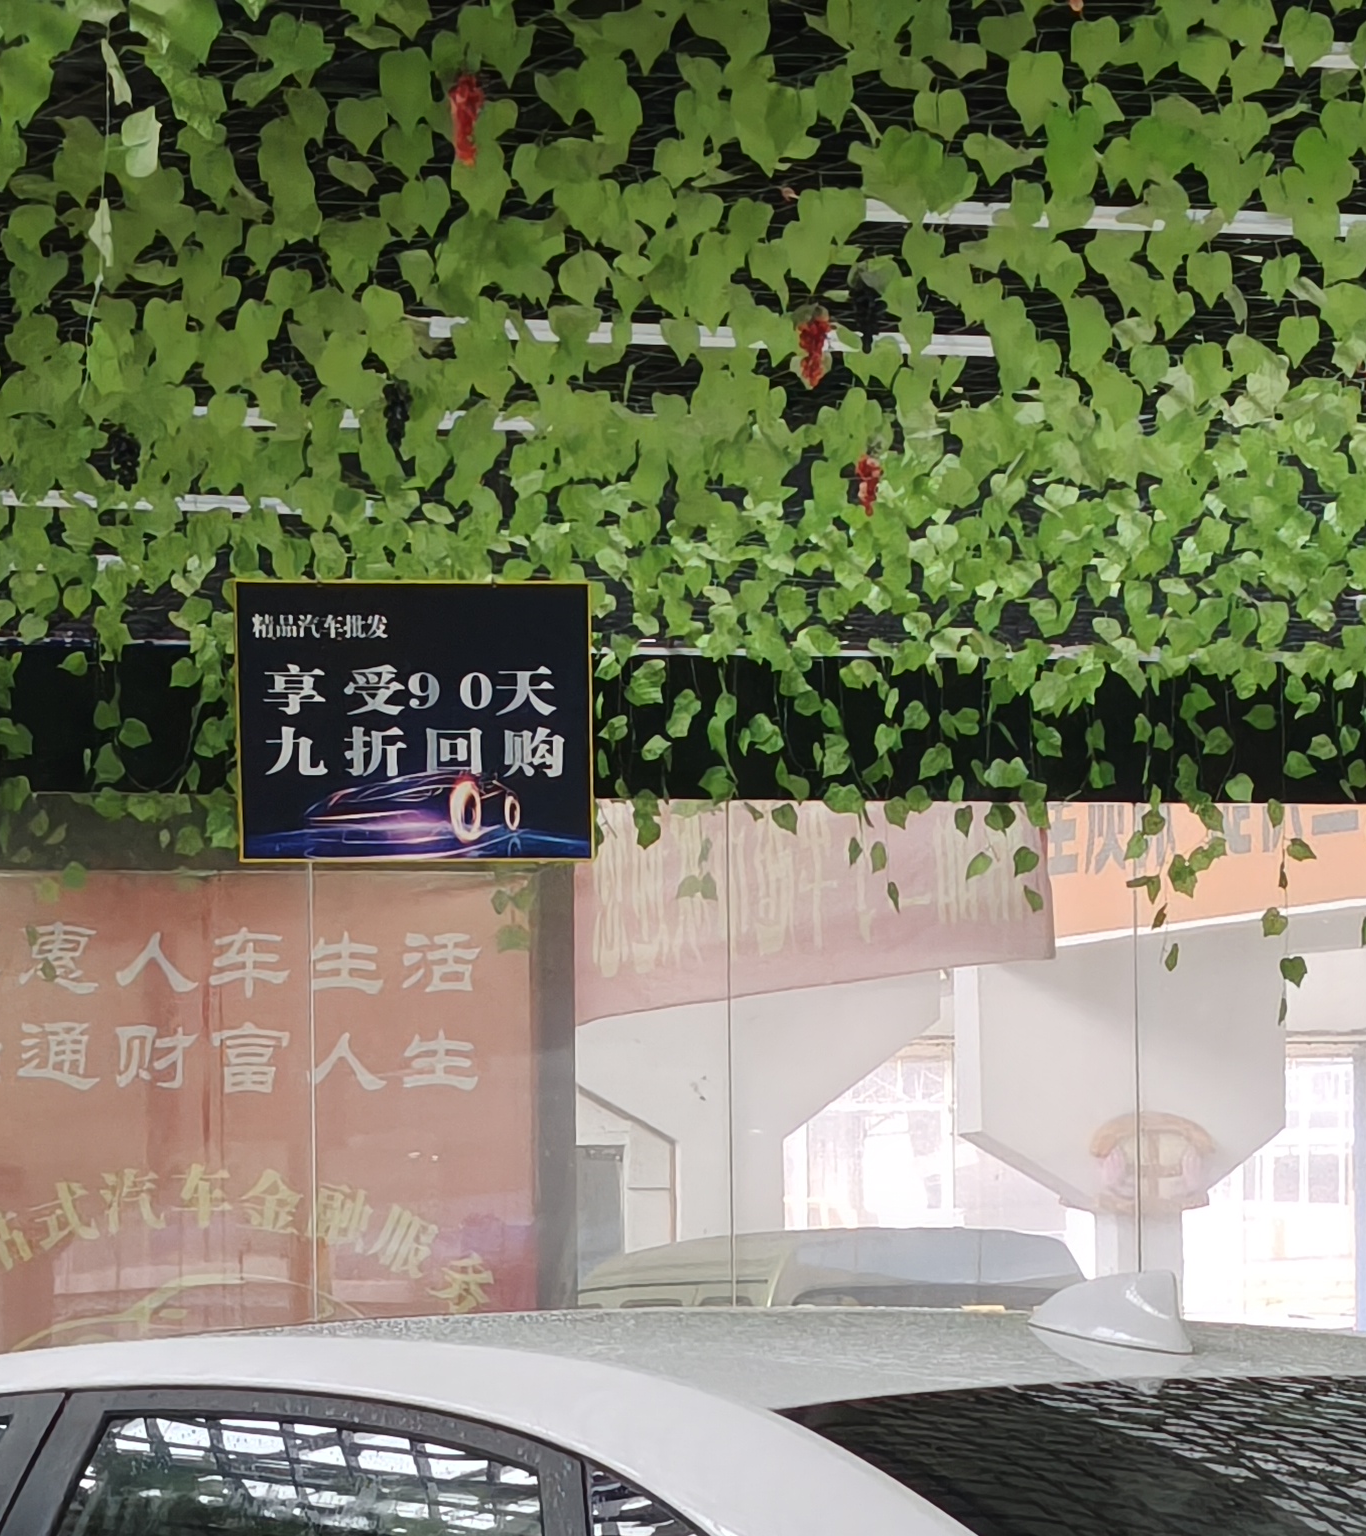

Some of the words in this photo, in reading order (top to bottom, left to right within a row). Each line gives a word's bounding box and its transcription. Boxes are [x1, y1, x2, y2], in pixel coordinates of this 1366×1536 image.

[251, 614, 388, 640] 精品汽车批发
[265, 726, 565, 778] 九折回购
